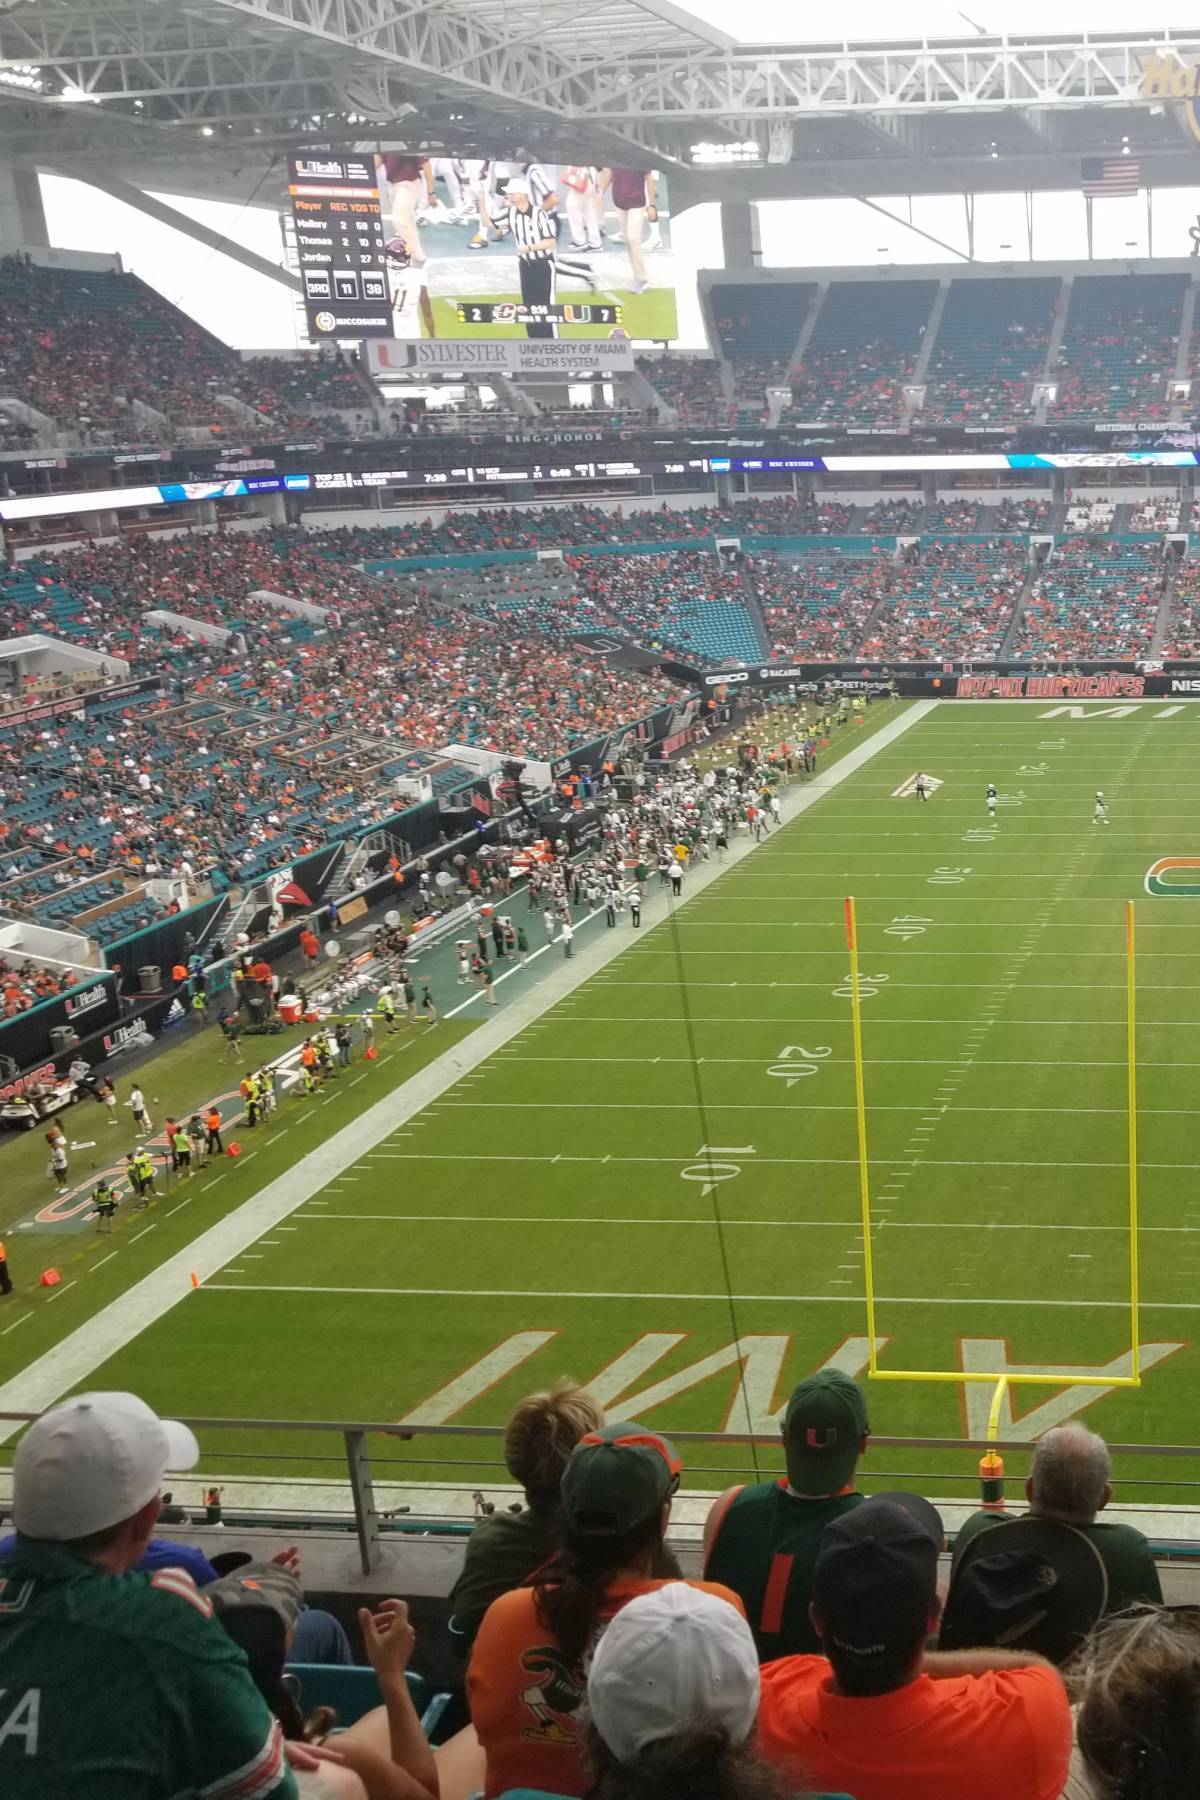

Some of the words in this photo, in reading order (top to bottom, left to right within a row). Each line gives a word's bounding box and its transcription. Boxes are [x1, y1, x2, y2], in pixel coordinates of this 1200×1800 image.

[295, 201, 322, 211] Player
[340, 221, 347, 230] 2
[301, 253, 332, 262] Jordan
[360, 255, 372, 263] 27
[308, 284, 329, 293] 3RD
[341, 283, 352, 294] 11
[472, 309, 481, 321] 2
[600, 309, 609, 322] 7
[420, 344, 507, 361] SYLVESTER
[519, 344, 577, 355] UNIVERSITY
[579, 344, 592, 354] OF
[594, 344, 627, 354] MIAMI
[520, 358, 559, 368] HEALTH
[560, 358, 600, 367] SYSTEM
[705, 672, 749, 685] GEICO
[806, 1427, 838, 1448] U
[759, 1552, 795, 1634] 1
